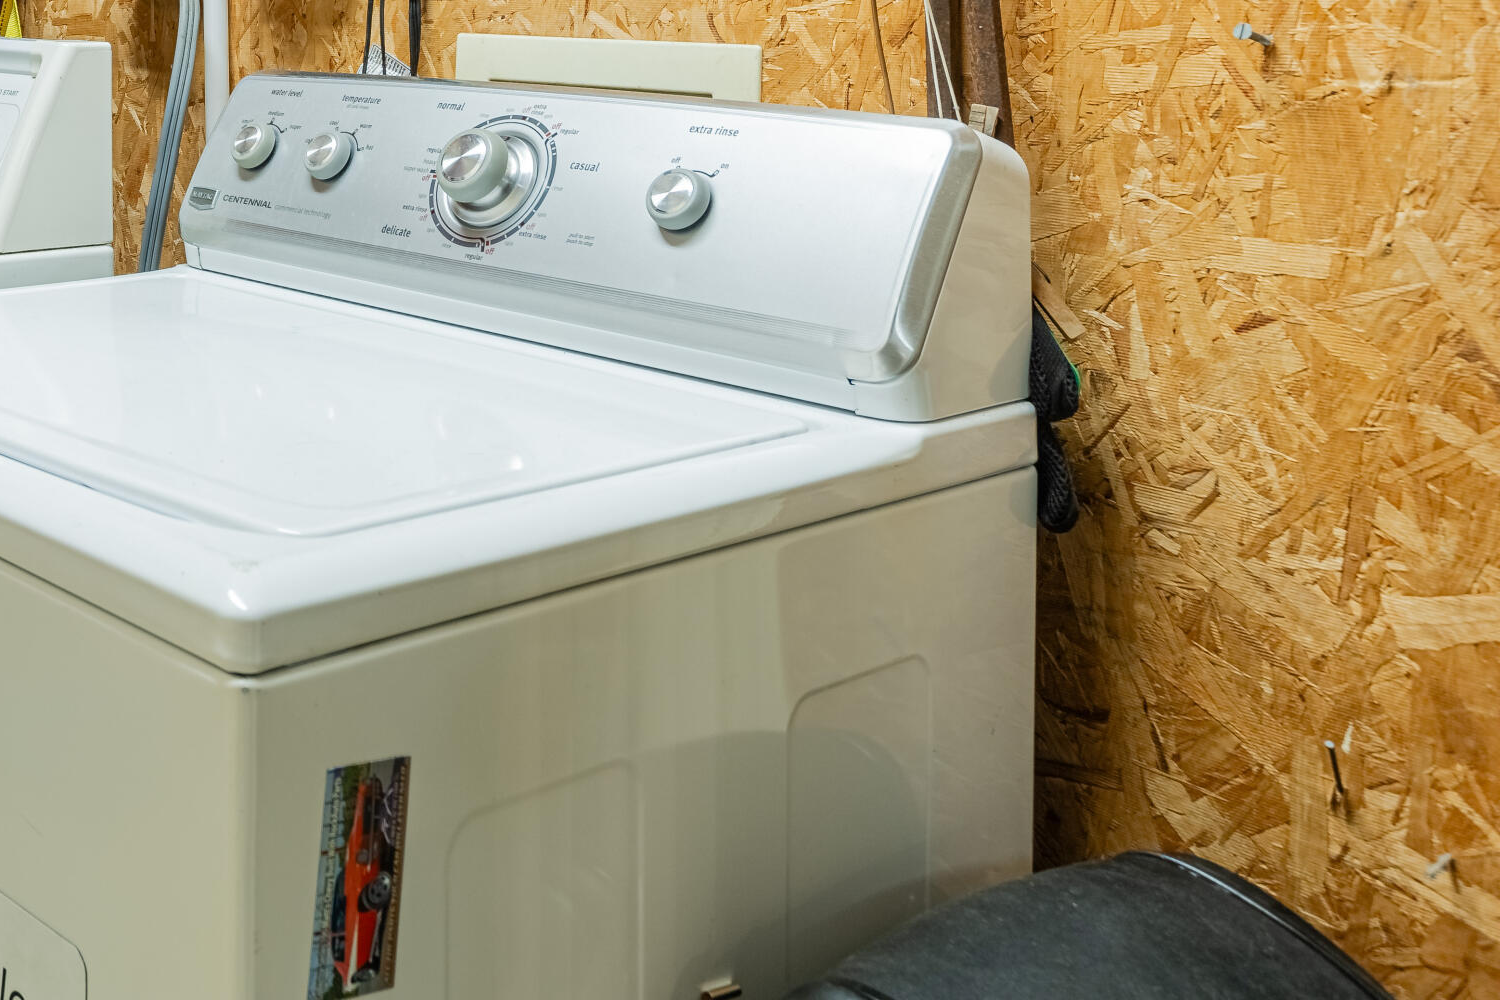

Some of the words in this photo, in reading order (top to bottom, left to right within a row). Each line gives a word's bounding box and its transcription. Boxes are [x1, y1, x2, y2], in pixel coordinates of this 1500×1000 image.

[271, 89, 288, 97] water
[289, 89, 303, 98] level
[342, 94, 382, 106] temperature
[437, 102, 466, 111] normal
[552, 122, 562, 130] off
[689, 125, 713, 135] extra
[715, 126, 740, 137] rinse
[560, 128, 580, 136] regular
[569, 161, 600, 172] casual
[223, 194, 272, 209] CENTENNIAL
[381, 224, 412, 238] delicate
[464, 253, 483, 261] regular
